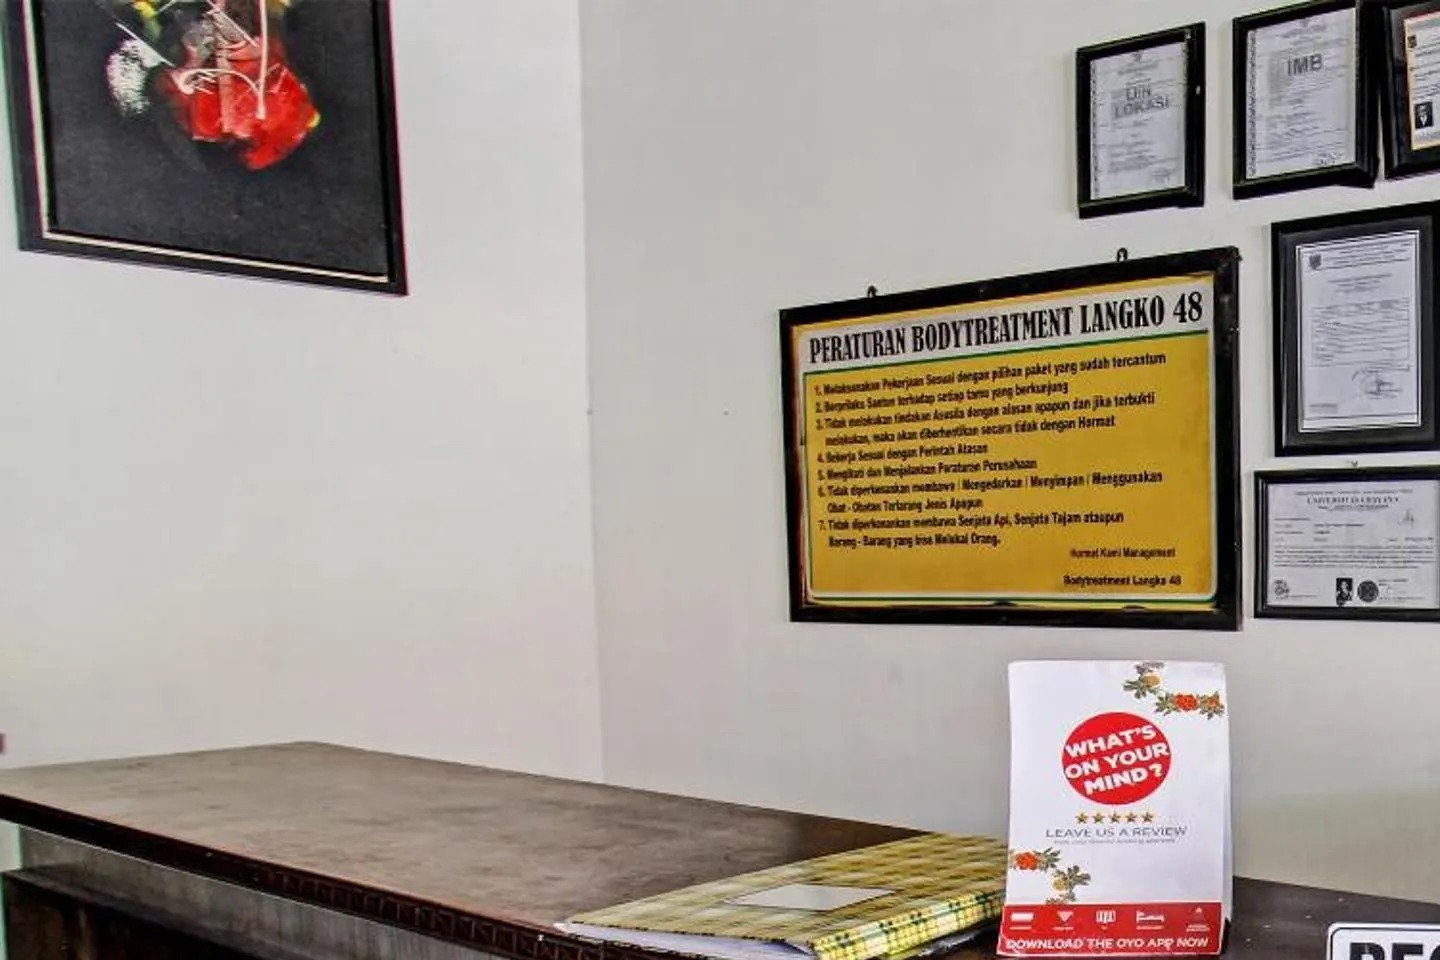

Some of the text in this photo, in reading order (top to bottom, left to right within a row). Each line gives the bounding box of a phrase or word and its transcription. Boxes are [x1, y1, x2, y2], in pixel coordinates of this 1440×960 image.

[1287, 54, 1323, 76] IMB
[809, 292, 1203, 364] PERATURAN BODYTREATMENT LANGKO 48
[957, 369, 989, 383] dengan
[992, 367, 1022, 382] pilihan
[1025, 363, 1051, 379] paket
[1054, 361, 1077, 376] yang
[1080, 358, 1110, 370] sudah
[1113, 352, 1167, 366] tercantum
[992, 385, 1013, 399] yang
[967, 405, 999, 419] dengan
[1002, 402, 1033, 415] alasan
[1035, 400, 1070, 414] apapun
[1072, 397, 1090, 409] dan
[1092, 395, 1112, 411] jika
[1114, 392, 1155, 405] terbukti
[981, 422, 1012, 436] secara
[1014, 420, 1038, 432] tidak
[1040, 418, 1076, 433] dengan
[1078, 415, 1115, 427] Hormat
[887, 447, 918, 461] dengan
[957, 444, 988, 454] Atasan
[1030, 475, 1085, 489] Menyimpan
[1092, 471, 1162, 487] Menggunakan
[925, 498, 948, 510] Jenis
[1014, 513, 1049, 528] Senjata
[1052, 511, 1081, 526] Tajam
[1083, 512, 1124, 526] ataupun
[894, 536, 913, 548] yang
[1123, 547, 1176, 560] Management
[1169, 575, 1182, 585] 48
[1066, 725, 1157, 758] WHAT'S
[1065, 743, 1170, 779] ON YOUR
[1046, 826, 1187, 838] LEAVE US A REVIEW
[1007, 937, 1208, 950] DOWNLOAD THE OYO APP NOW
